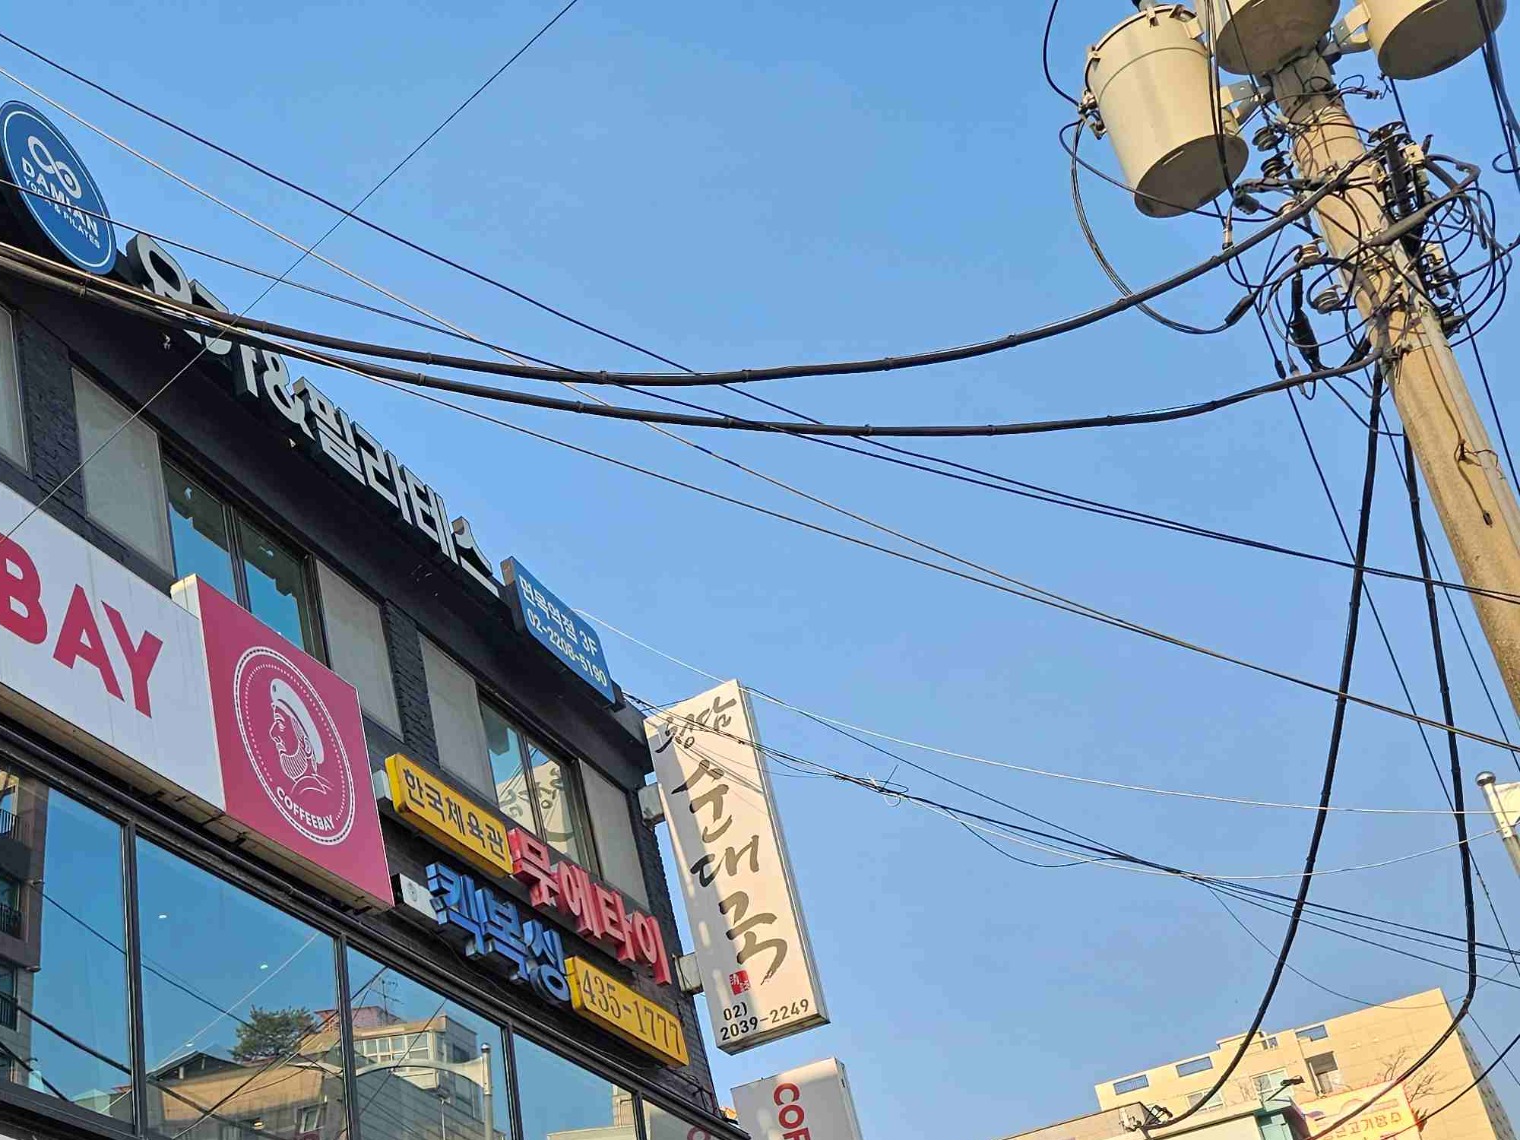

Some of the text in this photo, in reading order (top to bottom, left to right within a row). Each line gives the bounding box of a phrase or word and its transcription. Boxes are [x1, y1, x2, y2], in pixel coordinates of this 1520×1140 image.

[21, 157, 100, 239] DAMIAN
[519, 574, 598, 656] 면목역점 3F
[276, 786, 335, 831] COFFEEBAY
[402, 769, 505, 862] 한국체육관
[508, 827, 672, 987] 무에타이
[671, 759, 788, 985] 순대국
[426, 862, 572, 1003] 킥복싱
[582, 969, 682, 1056] 435-1777
[721, 998, 810, 1041] 2039-2249
[723, 1002, 748, 1021] 02)
